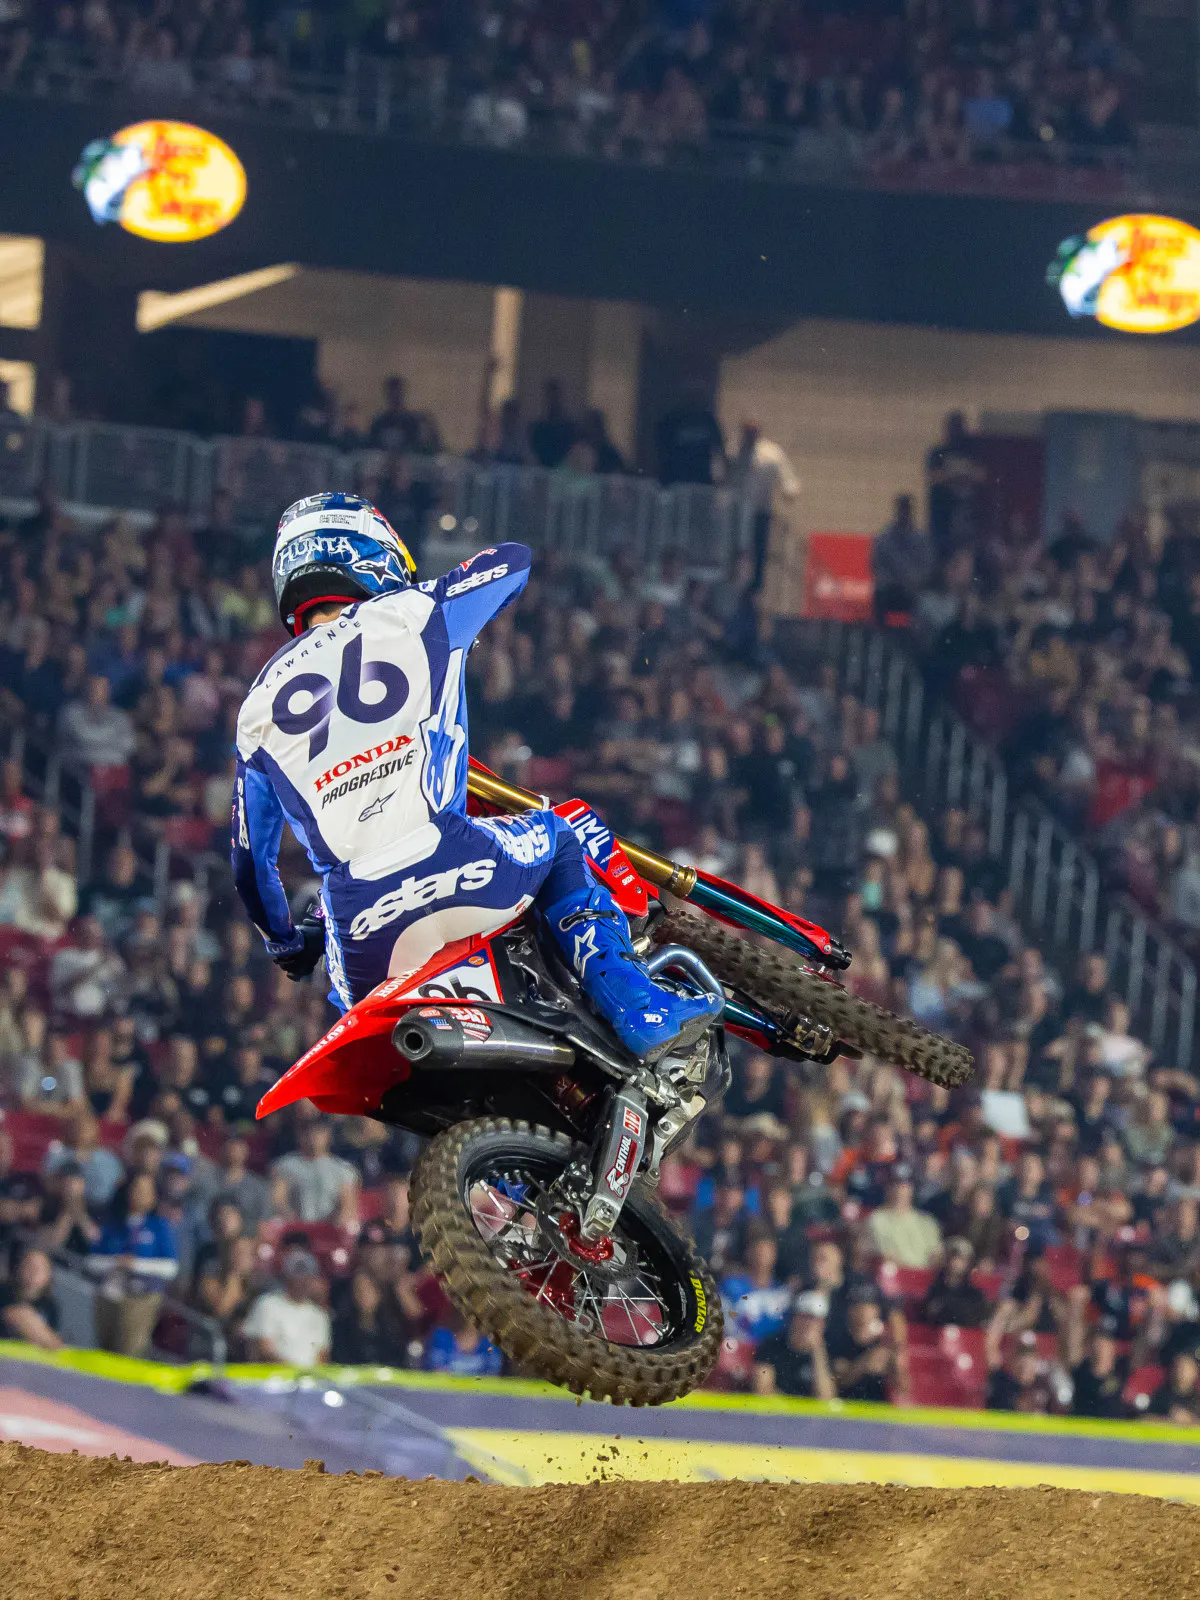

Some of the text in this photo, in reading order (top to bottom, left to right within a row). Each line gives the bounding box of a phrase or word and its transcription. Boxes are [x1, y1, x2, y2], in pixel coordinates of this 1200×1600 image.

[278, 536, 360, 576] HUNTA
[265, 620, 362, 689] LAWRENCE
[271, 633, 410, 762] 96
[313, 734, 416, 793] HONDA
[321, 751, 415, 810] PROGRESSIVE
[349, 858, 498, 941] astars
[690, 1277, 707, 1333] DUNLOP
